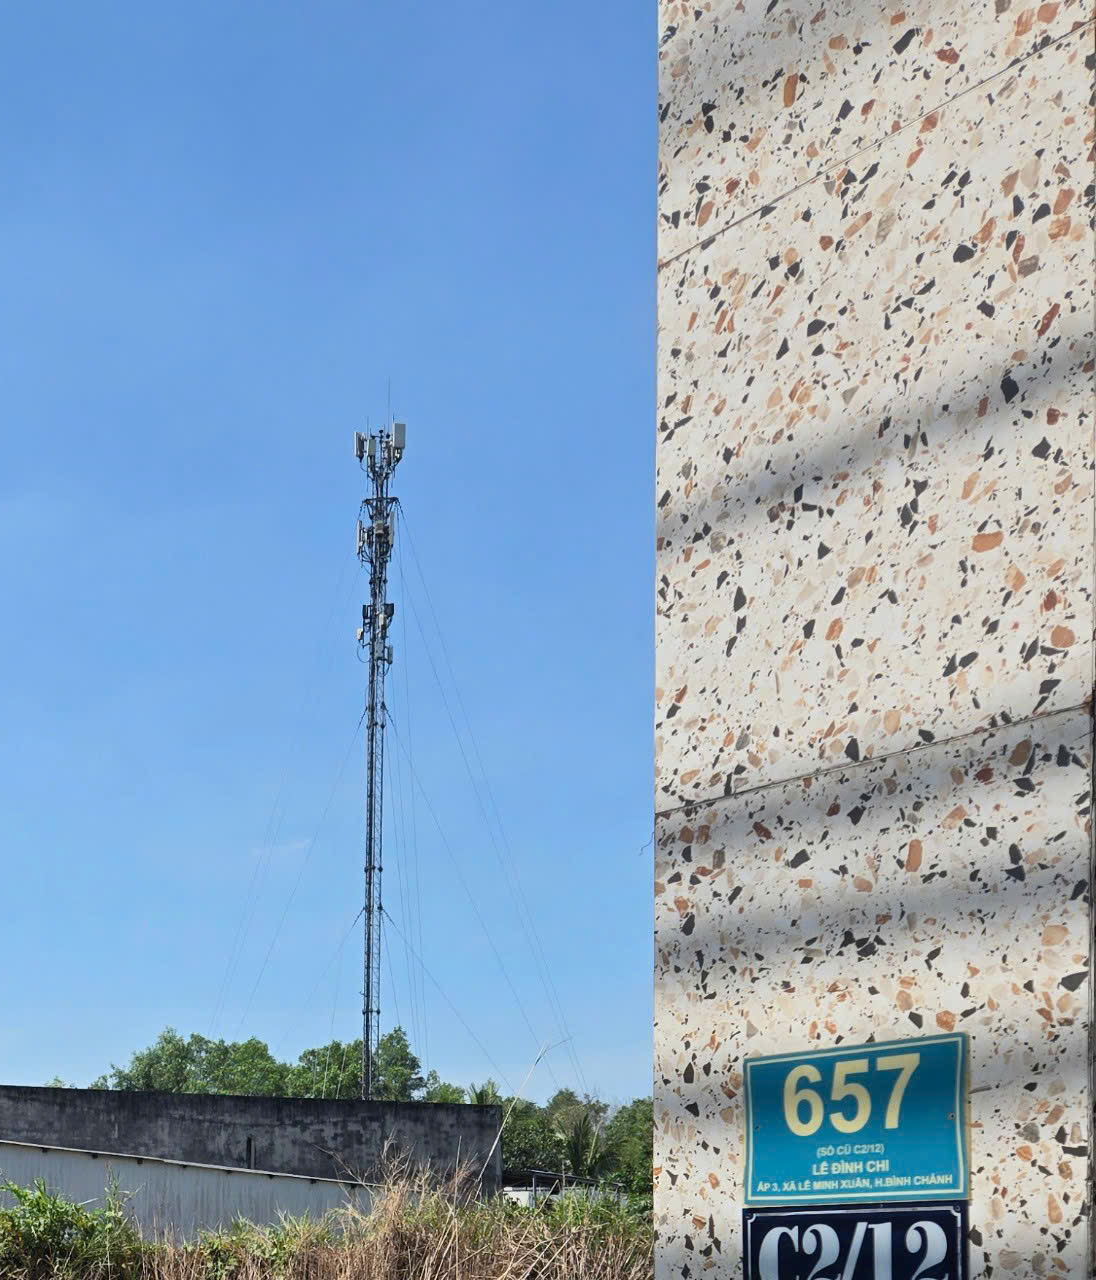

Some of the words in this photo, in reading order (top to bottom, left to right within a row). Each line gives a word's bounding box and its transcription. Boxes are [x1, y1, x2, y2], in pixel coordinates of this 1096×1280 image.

[783, 1052, 921, 1137] 657
[853, 1143, 885, 1156] C2/12)
[812, 1161, 829, 1176] LÊ
[831, 1160, 864, 1175] ĐÌNH
[865, 1159, 890, 1173] CHI
[782, 1179, 797, 1192] XÃ
[798, 1178, 812, 1191] LÊ
[813, 1180, 839, 1191] MINH
[840, 1176, 872, 1190] XUÂN,
[875, 1174, 912, 1188] H.BÌNH
[912, 1173, 953, 1187] CHÁNH
